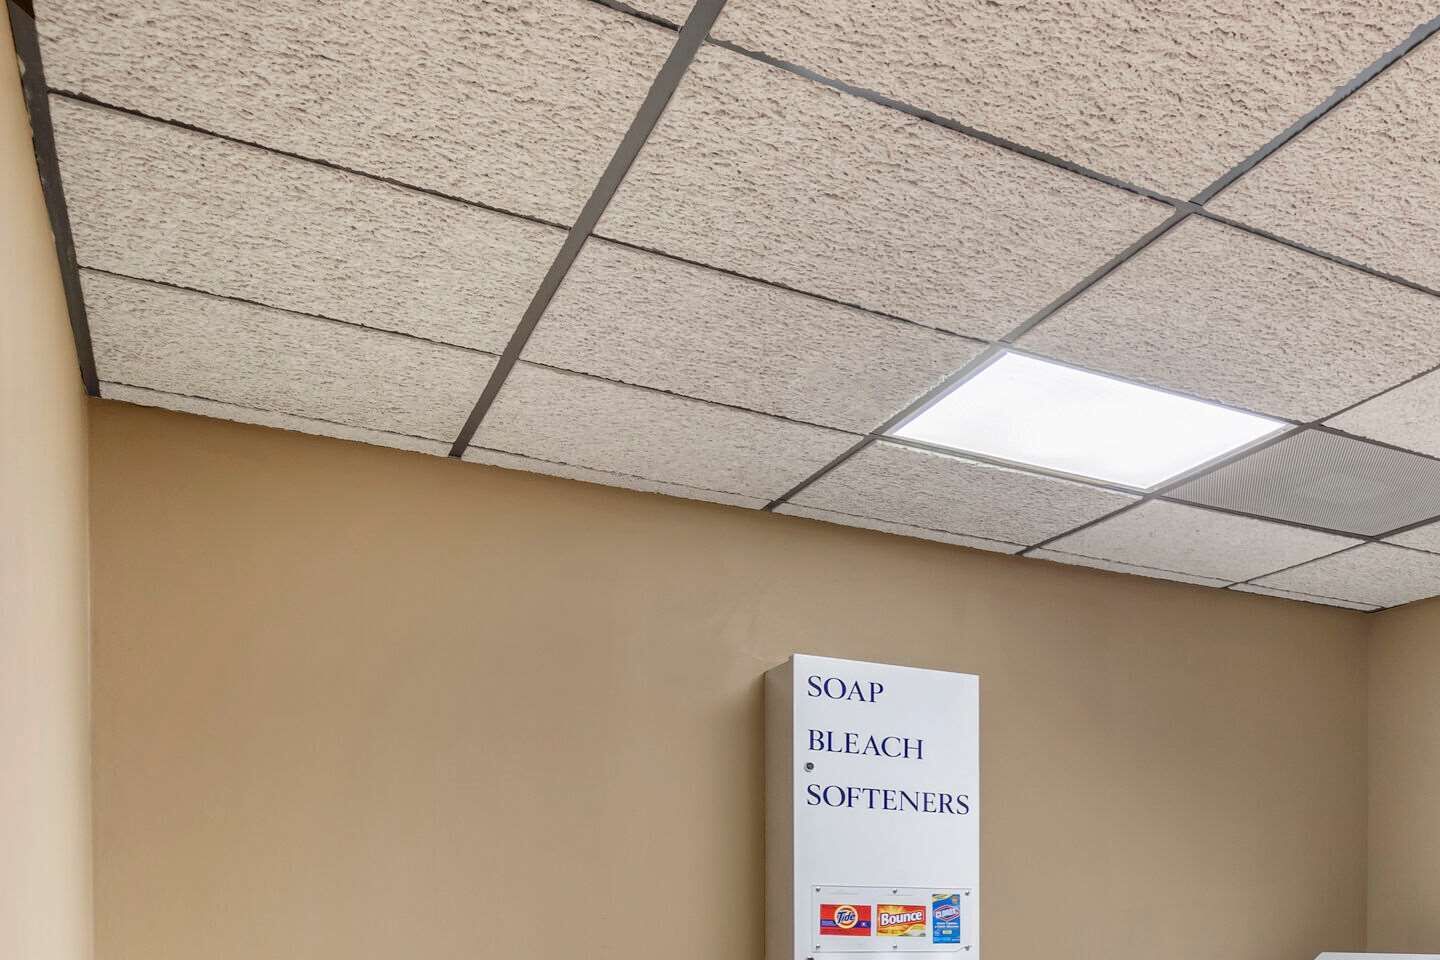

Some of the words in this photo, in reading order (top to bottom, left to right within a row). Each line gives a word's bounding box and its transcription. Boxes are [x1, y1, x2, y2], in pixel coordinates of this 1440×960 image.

[807, 675, 884, 703] SOAP
[807, 729, 924, 760] BLEACH
[807, 783, 970, 816] SOFTENERS
[837, 911, 855, 924] Tide
[880, 911, 923, 926] Bounce
